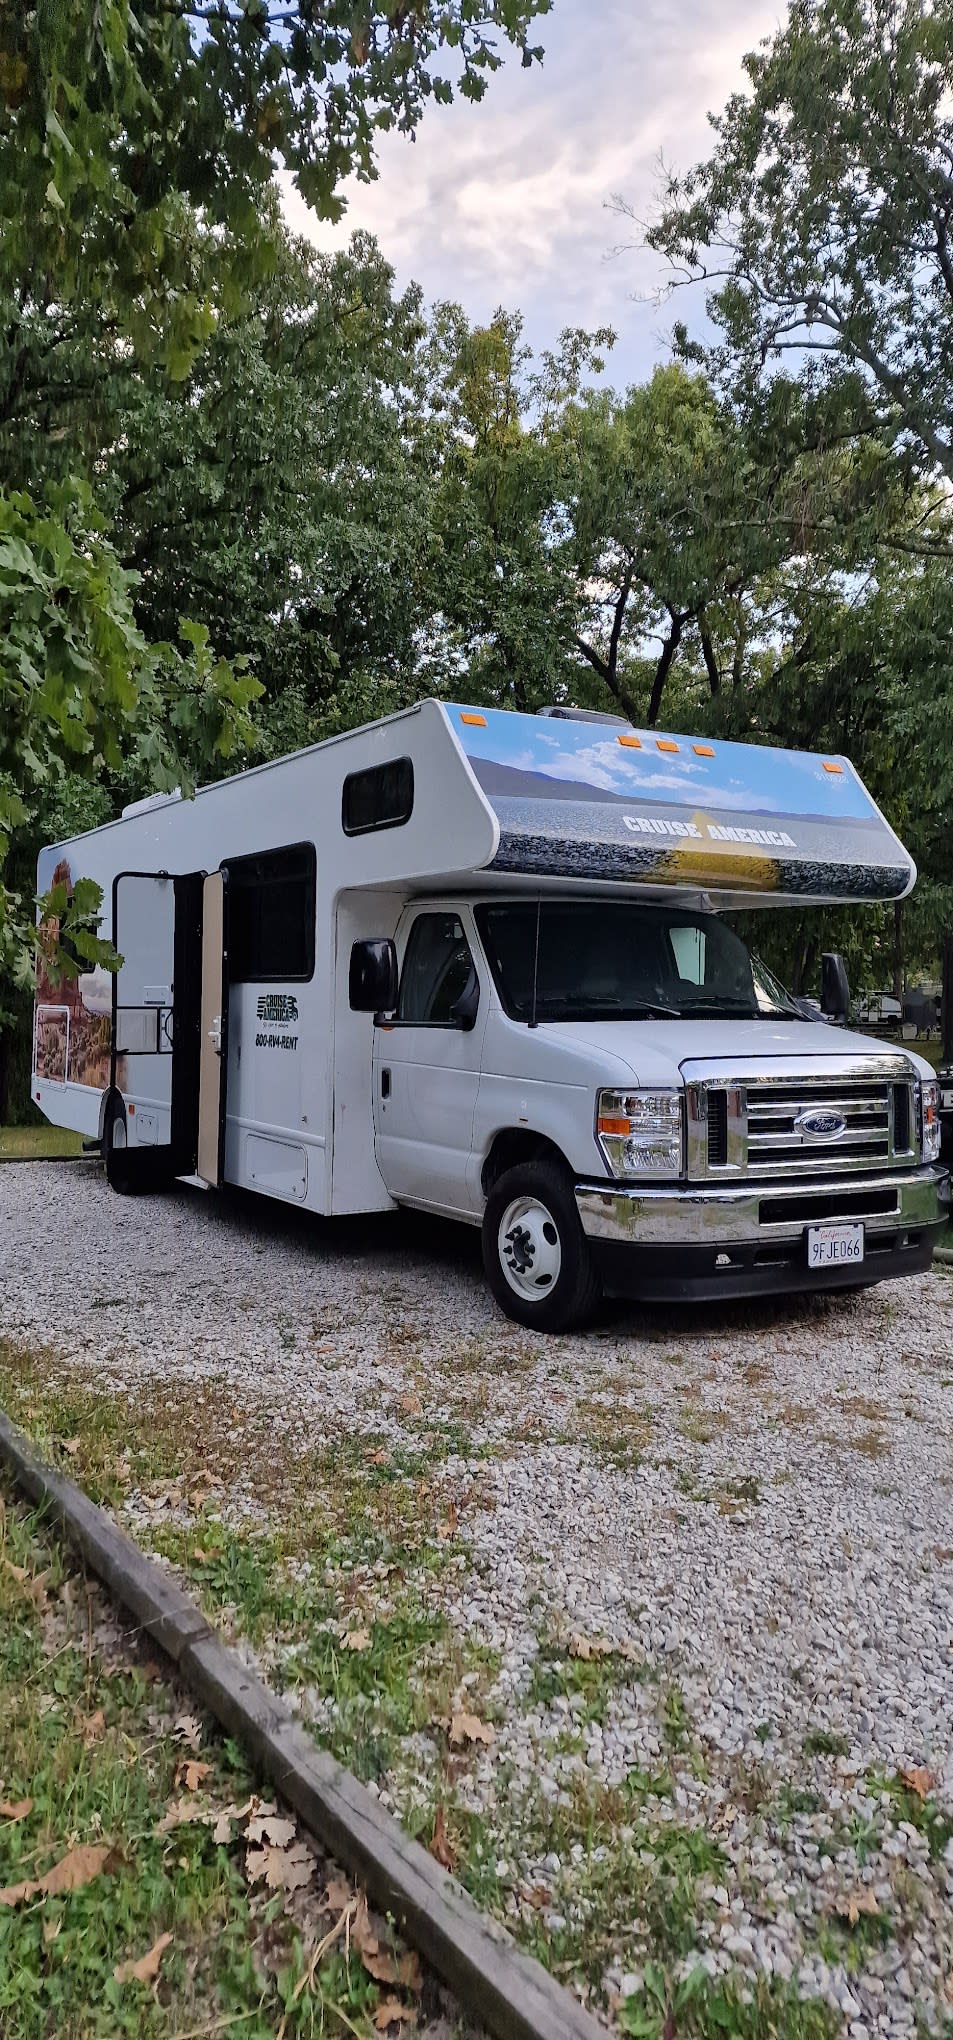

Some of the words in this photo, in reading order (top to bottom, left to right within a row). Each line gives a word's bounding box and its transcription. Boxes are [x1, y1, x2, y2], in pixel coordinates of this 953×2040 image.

[622, 815, 703, 838] CRUISE
[706, 824, 798, 848] AMERICA
[265, 994, 288, 1008] CRUISE
[263, 1007, 290, 1022] AMERICA
[813, 1239, 860, 1260] 9FJE066
